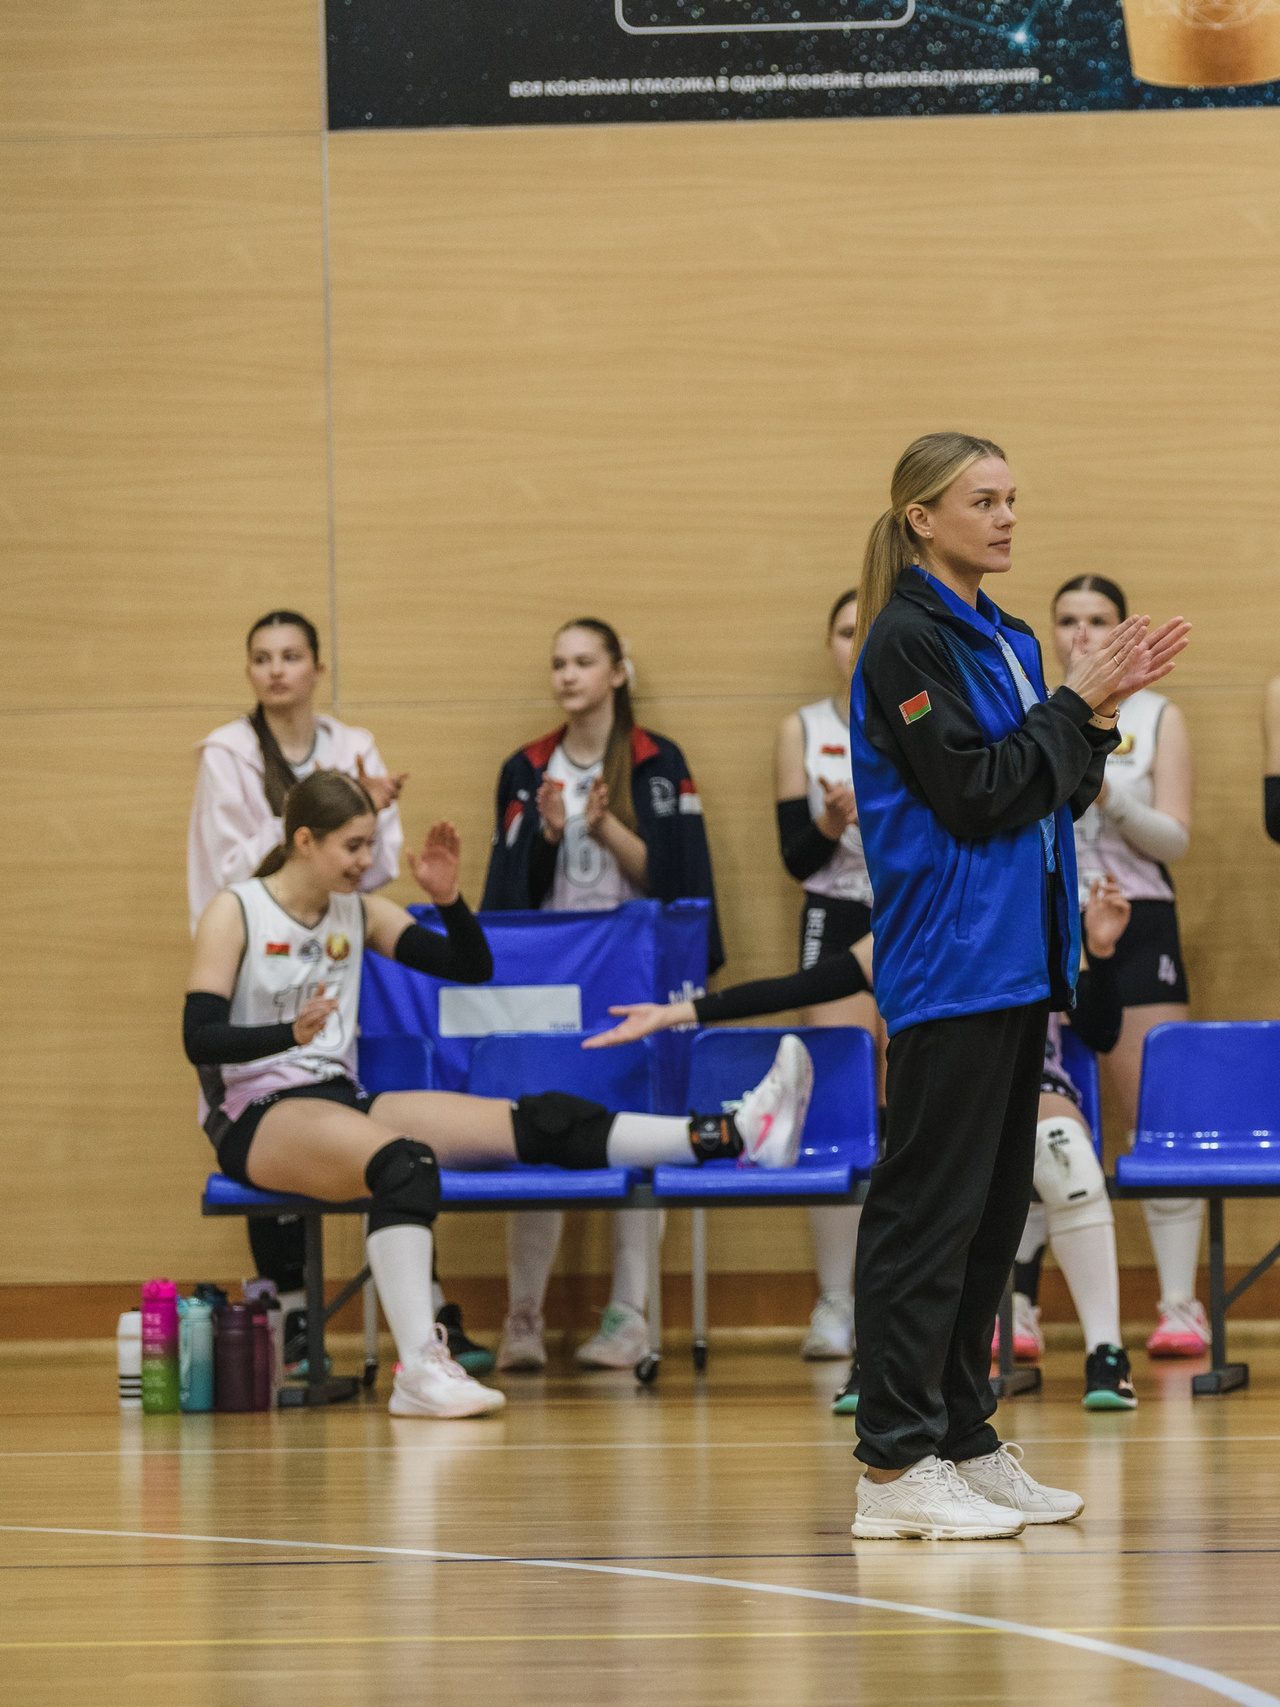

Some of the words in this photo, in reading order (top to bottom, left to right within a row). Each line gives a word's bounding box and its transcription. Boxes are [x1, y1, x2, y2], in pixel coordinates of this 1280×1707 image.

[509, 81, 543, 98] ВСЯ
[544, 77, 630, 97] КОФЕЙНАЯ
[631, 75, 716, 94] КЛАССИКА
[716, 76, 729, 92] В
[730, 72, 787, 94] ОДНОЙ
[788, 70, 863, 90] КОФЕЙНЕ
[864, 67, 1040, 88] САМООБСЛУЖИВАНИЯ
[803, 908, 826, 970] BELARU
